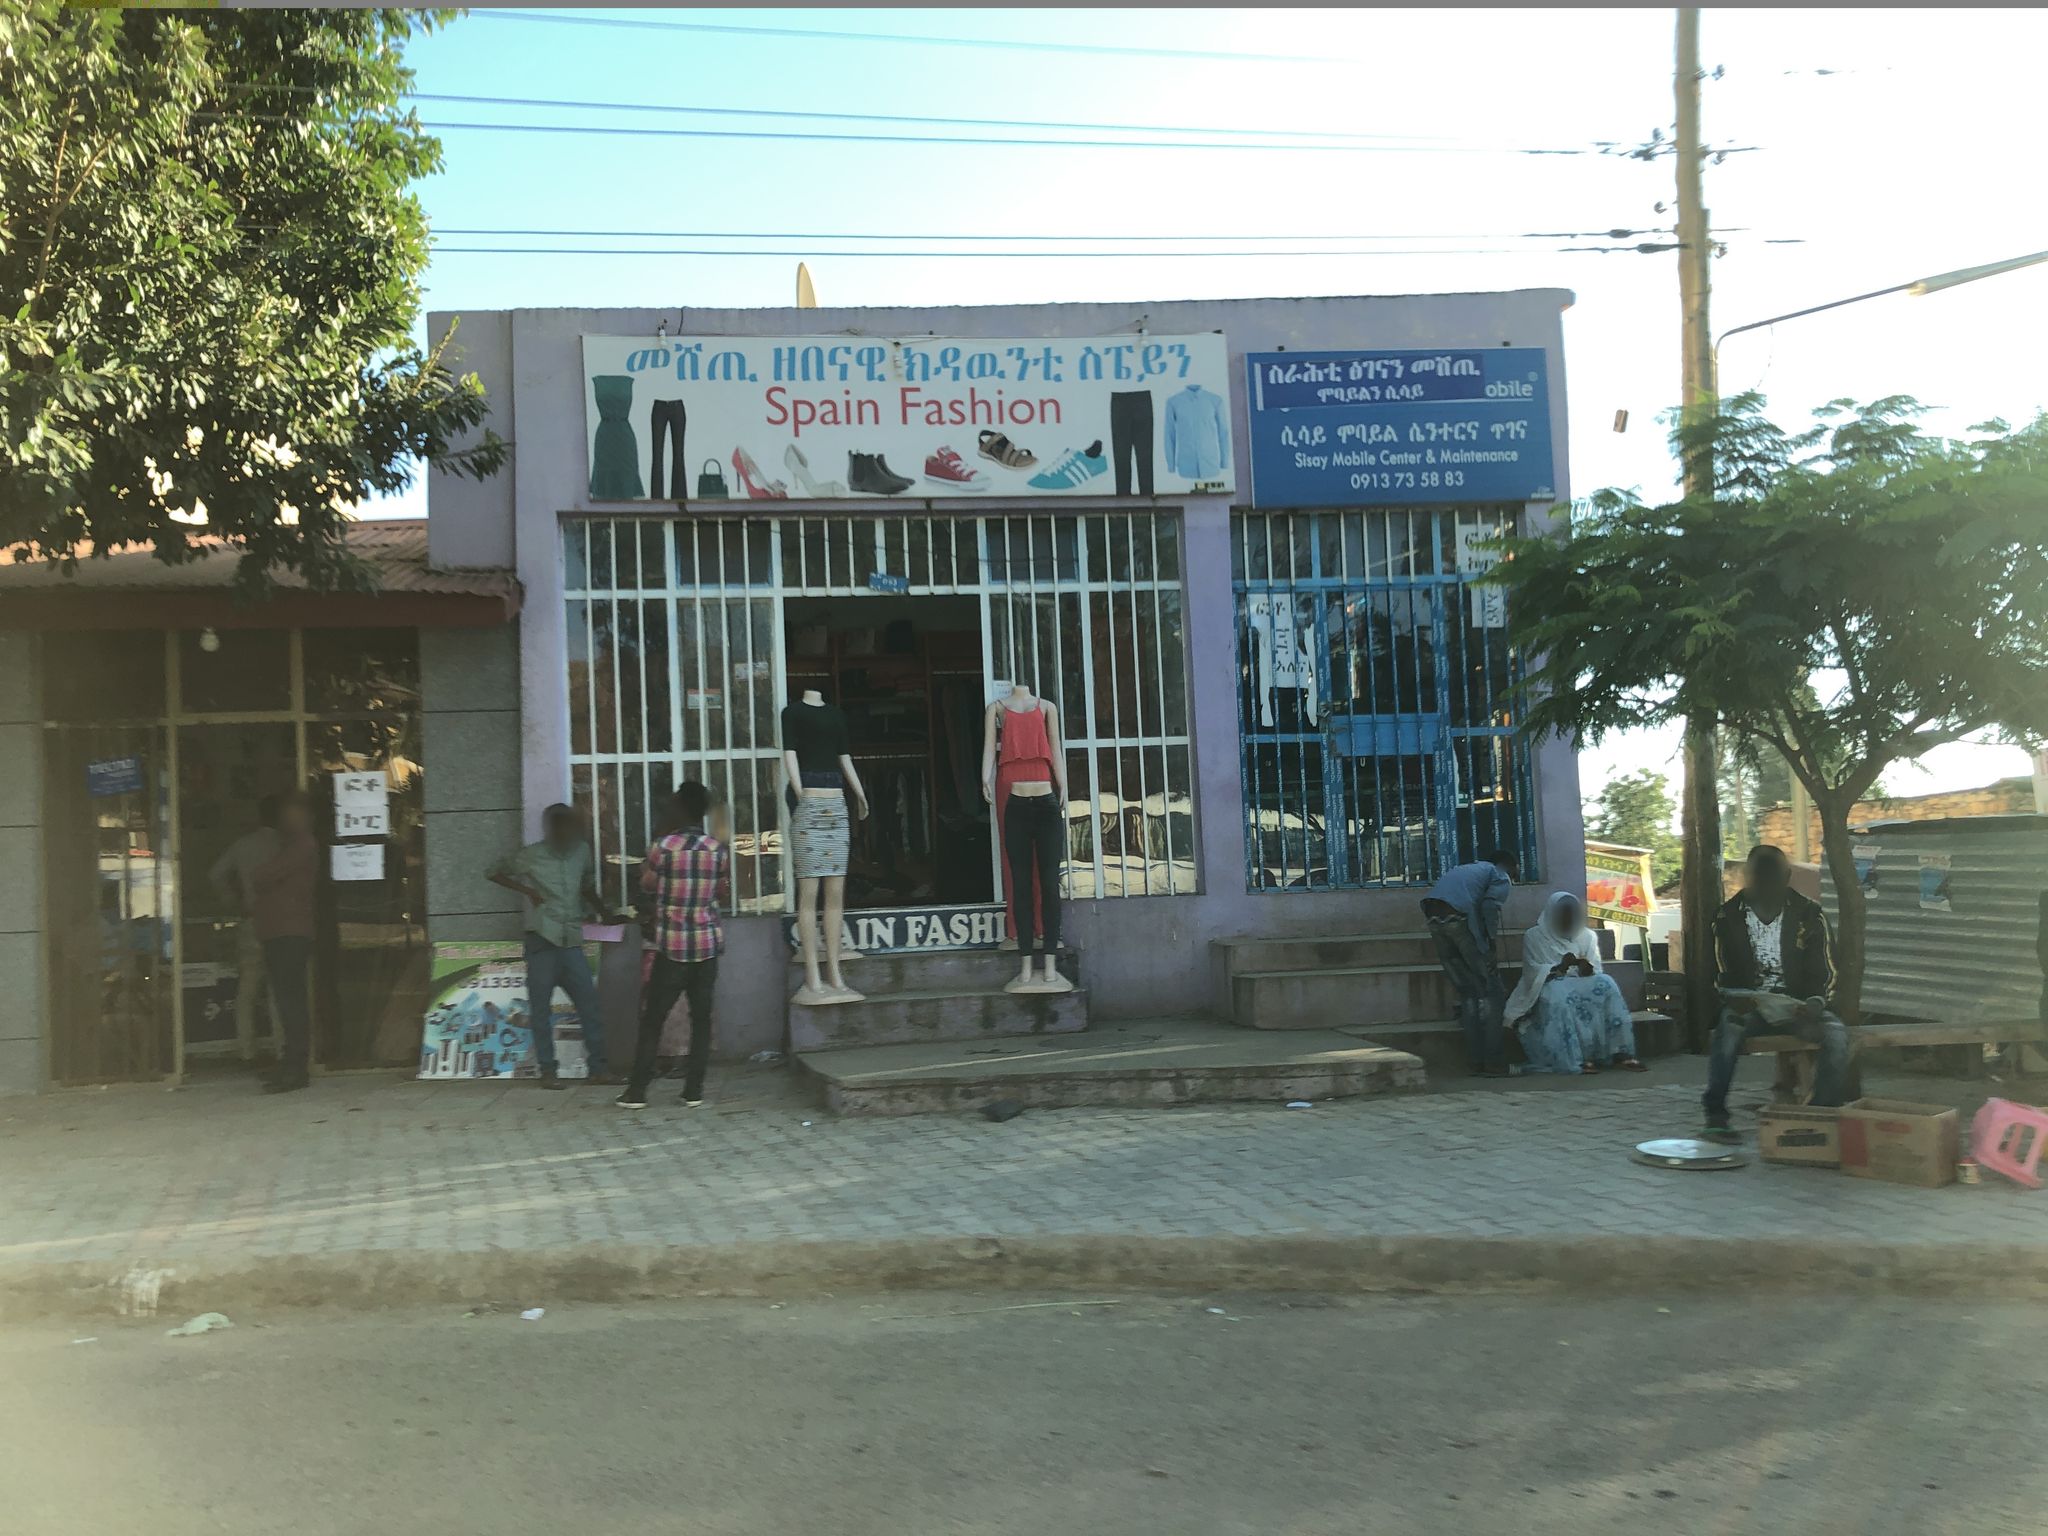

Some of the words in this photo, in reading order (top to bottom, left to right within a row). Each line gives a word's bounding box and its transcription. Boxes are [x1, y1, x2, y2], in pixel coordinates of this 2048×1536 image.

[773, 345, 887, 383] ዘበናዊ
[1079, 344, 1191, 382] ስፔይን
[766, 386, 880, 437] Spain
[900, 389, 1062, 426] Fashion
[1295, 452, 1328, 470] Sisay
[1332, 450, 1376, 467] Mobile
[1380, 449, 1422, 466] Center
[1426, 449, 1436, 465] &
[1440, 448, 1519, 464] Maintenance
[1350, 473, 1390, 490] 0913
[1395, 472, 1418, 489] 73
[1421, 471, 1439, 488] 58
[1445, 470, 1464, 487] 83
